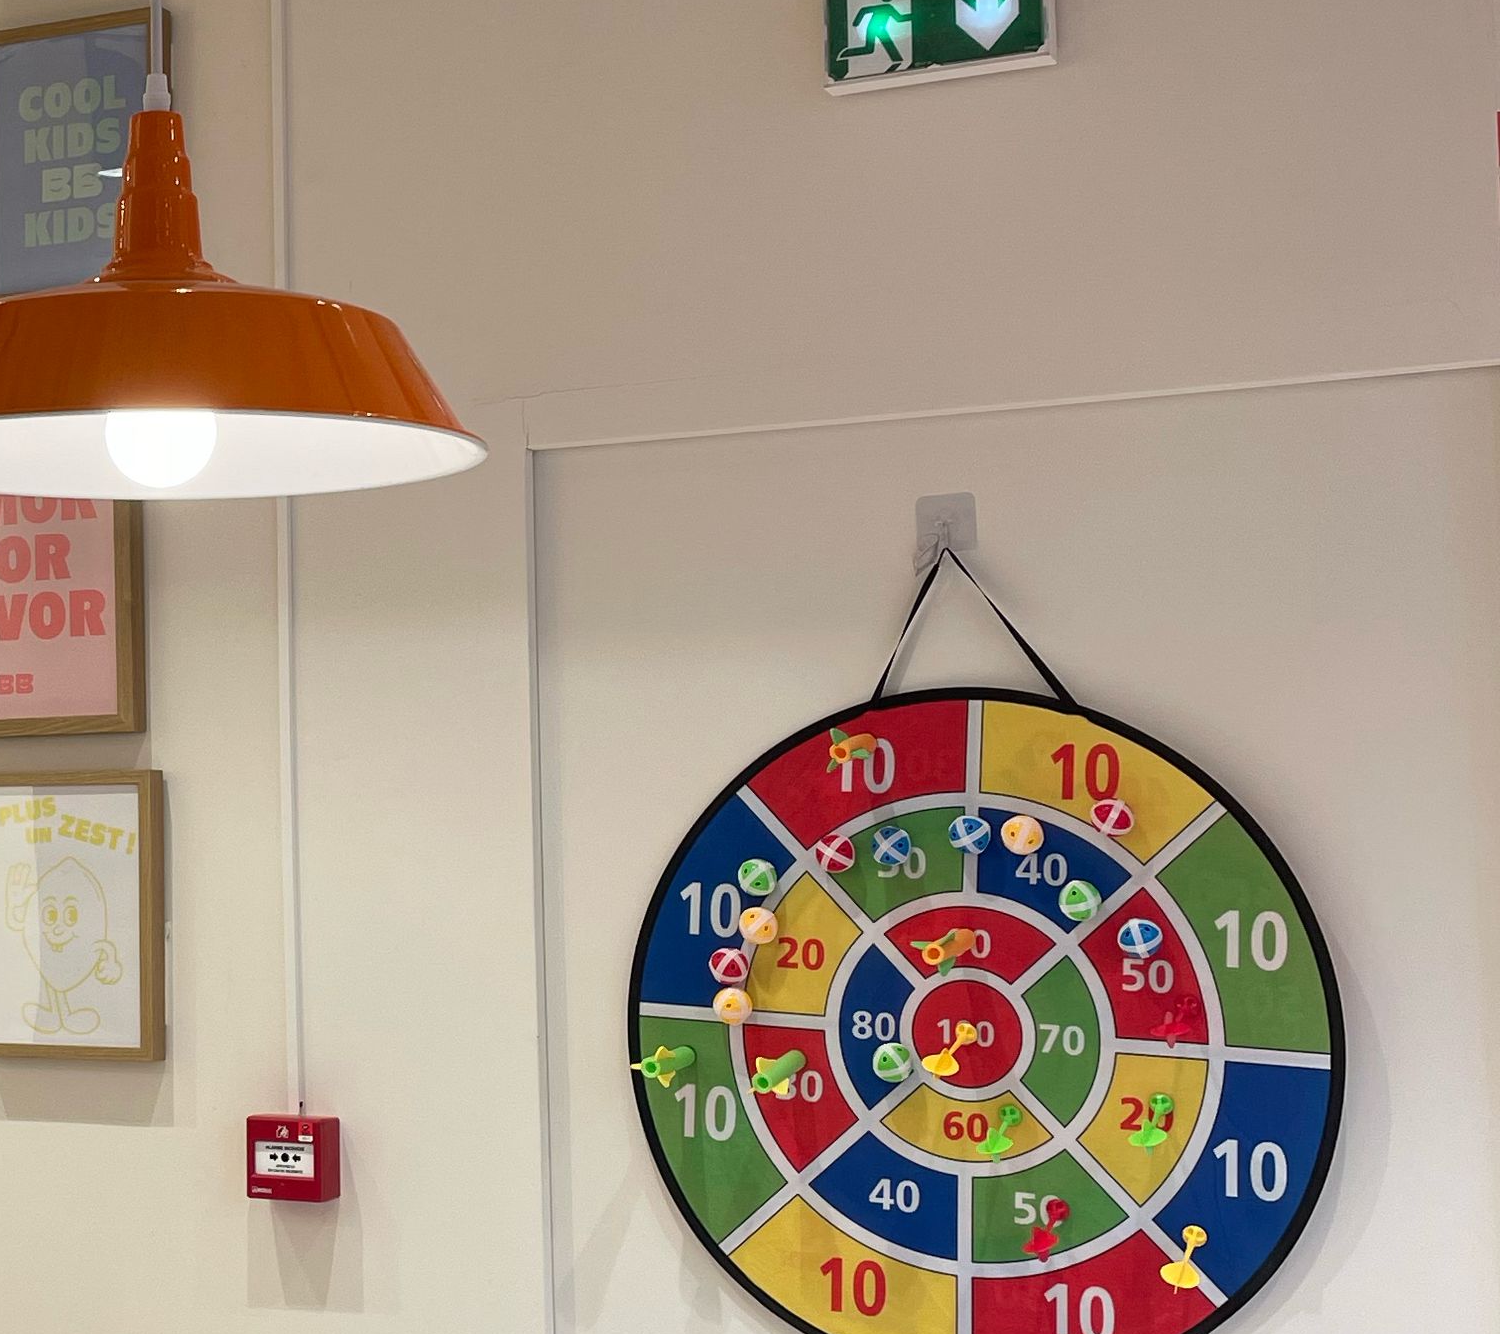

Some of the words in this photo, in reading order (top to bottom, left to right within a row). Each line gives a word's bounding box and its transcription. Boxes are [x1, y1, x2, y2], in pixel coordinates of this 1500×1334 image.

[18, 75, 126, 122] COOL
[24, 117, 121, 164] KIDS
[41, 163, 104, 203] BB
[24, 202, 116, 248] KIDS
[841, 738, 895, 794] 10
[1050, 743, 1120, 801] 10
[25, 827, 52, 844] UN
[1015, 853, 1068, 887] 40
[680, 882, 742, 938] 10
[776, 937, 825, 970] 20
[1214, 910, 1288, 971] 10
[1121, 958, 1174, 994] 50
[852, 1011, 896, 1041] 80
[937, 1019, 995, 1048] 10
[1039, 1024, 1085, 1056] 70
[674, 1083, 737, 1141] 10
[943, 1111, 988, 1142] 60
[1213, 1139, 1288, 1202] 10
[869, 1178, 920, 1213] 40
[1014, 1191, 1063, 1227] 50
[820, 1257, 887, 1317] 10
